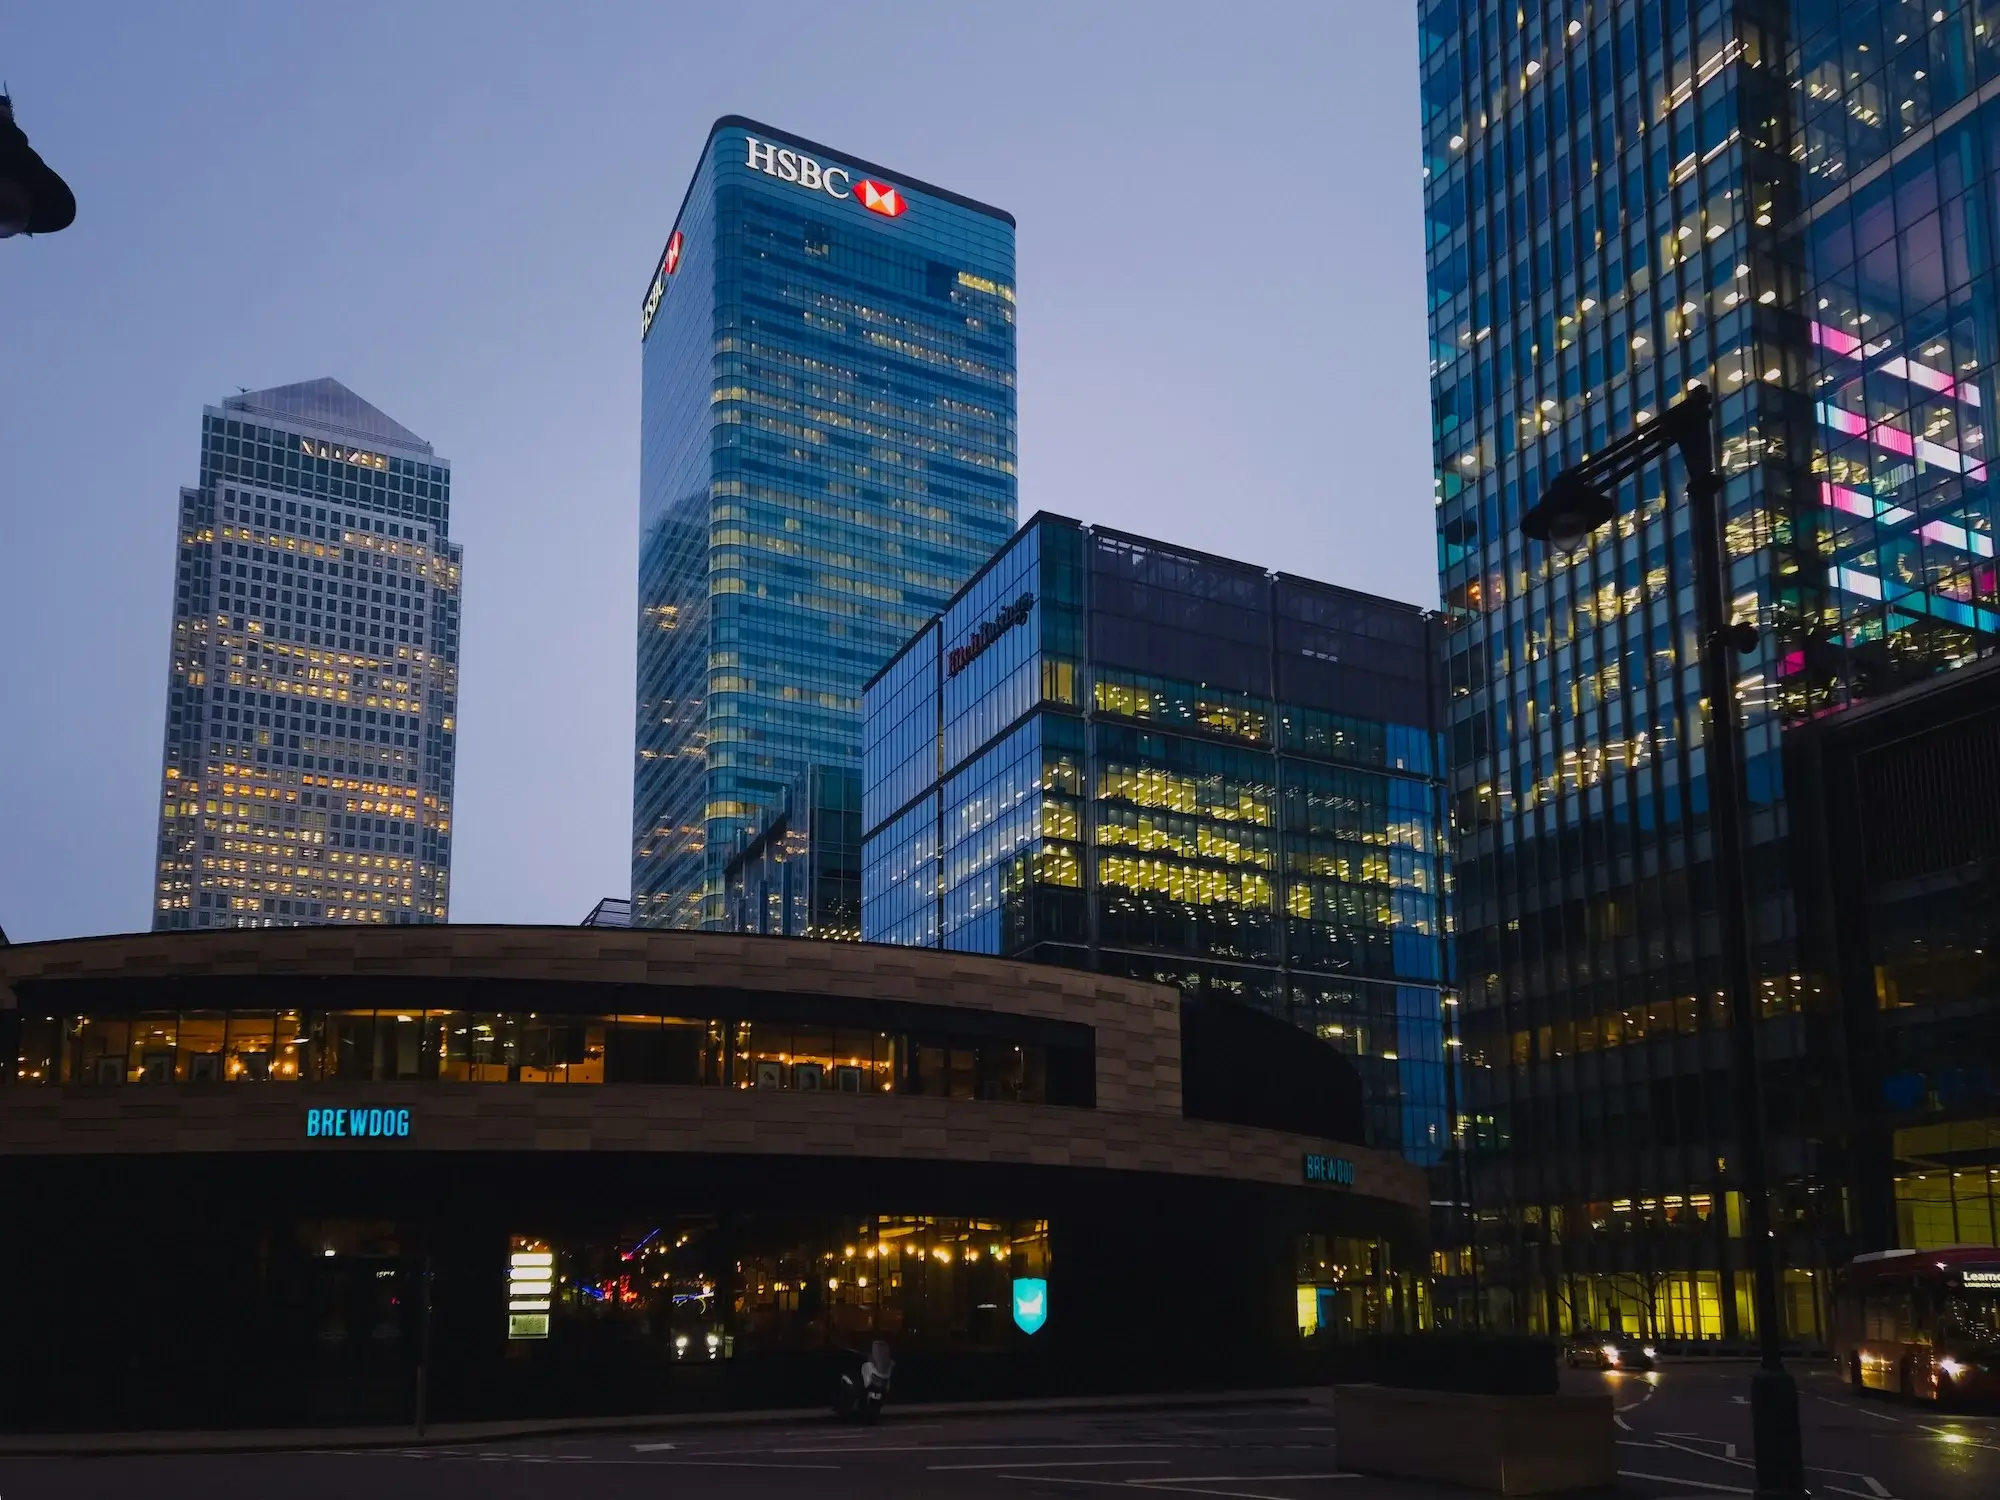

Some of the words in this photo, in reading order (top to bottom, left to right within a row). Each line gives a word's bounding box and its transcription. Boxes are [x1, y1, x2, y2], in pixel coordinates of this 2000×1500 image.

[745, 136, 849, 199] HSBC
[641, 262, 666, 339] HSBC
[306, 1108, 410, 1137] BREWDOG
